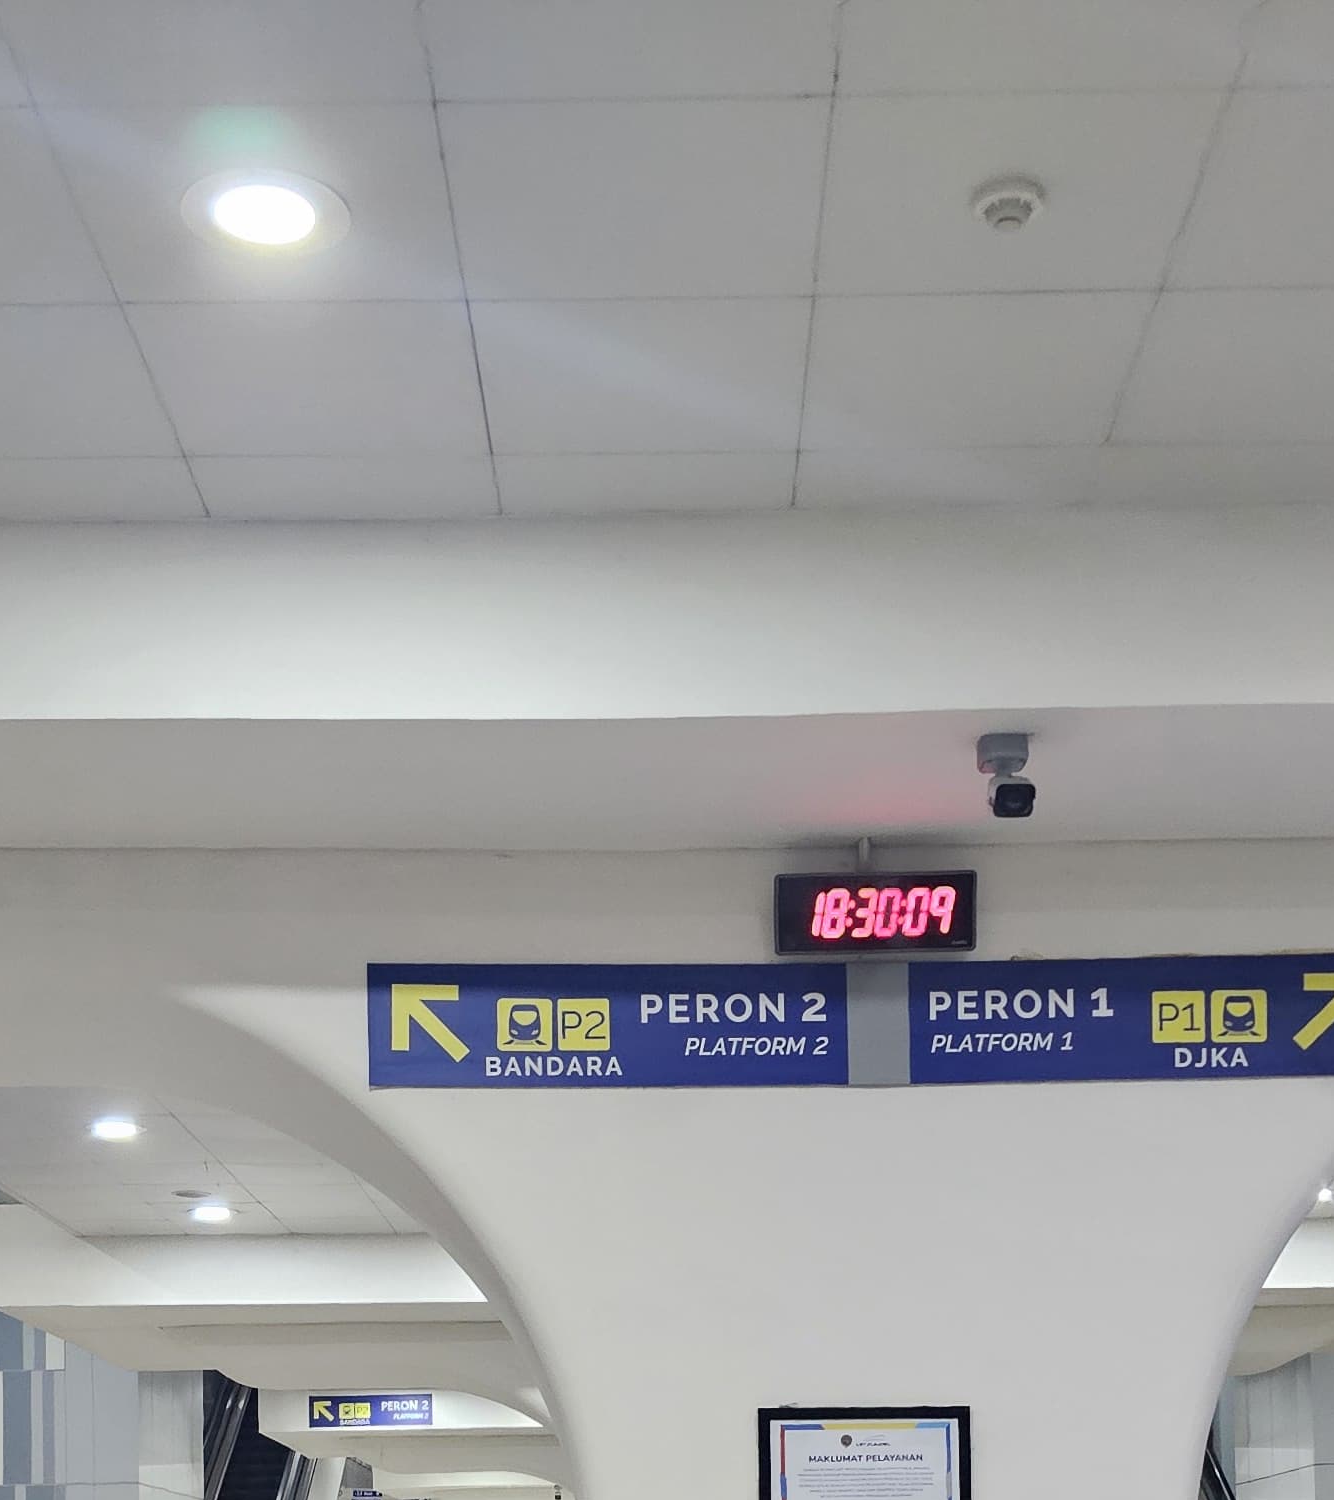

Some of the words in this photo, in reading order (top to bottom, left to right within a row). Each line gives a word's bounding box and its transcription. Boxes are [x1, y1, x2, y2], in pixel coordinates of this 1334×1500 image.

[811, 886, 956, 939] 18:30:09
[640, 993, 785, 1023] PERON
[801, 992, 828, 1022] 2
[928, 988, 1075, 1021] PERON
[1089, 987, 1114, 1017] 1
[561, 1010, 607, 1040] P2
[1157, 1002, 1201, 1032] P1
[684, 1037, 806, 1056] PLATFORM
[813, 1036, 829, 1055] 2
[930, 1032, 1054, 1054] PLATFORM
[1060, 1031, 1074, 1051] 1
[485, 1056, 623, 1077] BANDARA
[1174, 1046, 1249, 1069] DJKA
[381, 1400, 418, 1411] PERON
[422, 1400, 429, 1410] 2
[808, 1454, 864, 1463] MAKLUMAT
[866, 1453, 923, 1462] PELAYANAN
